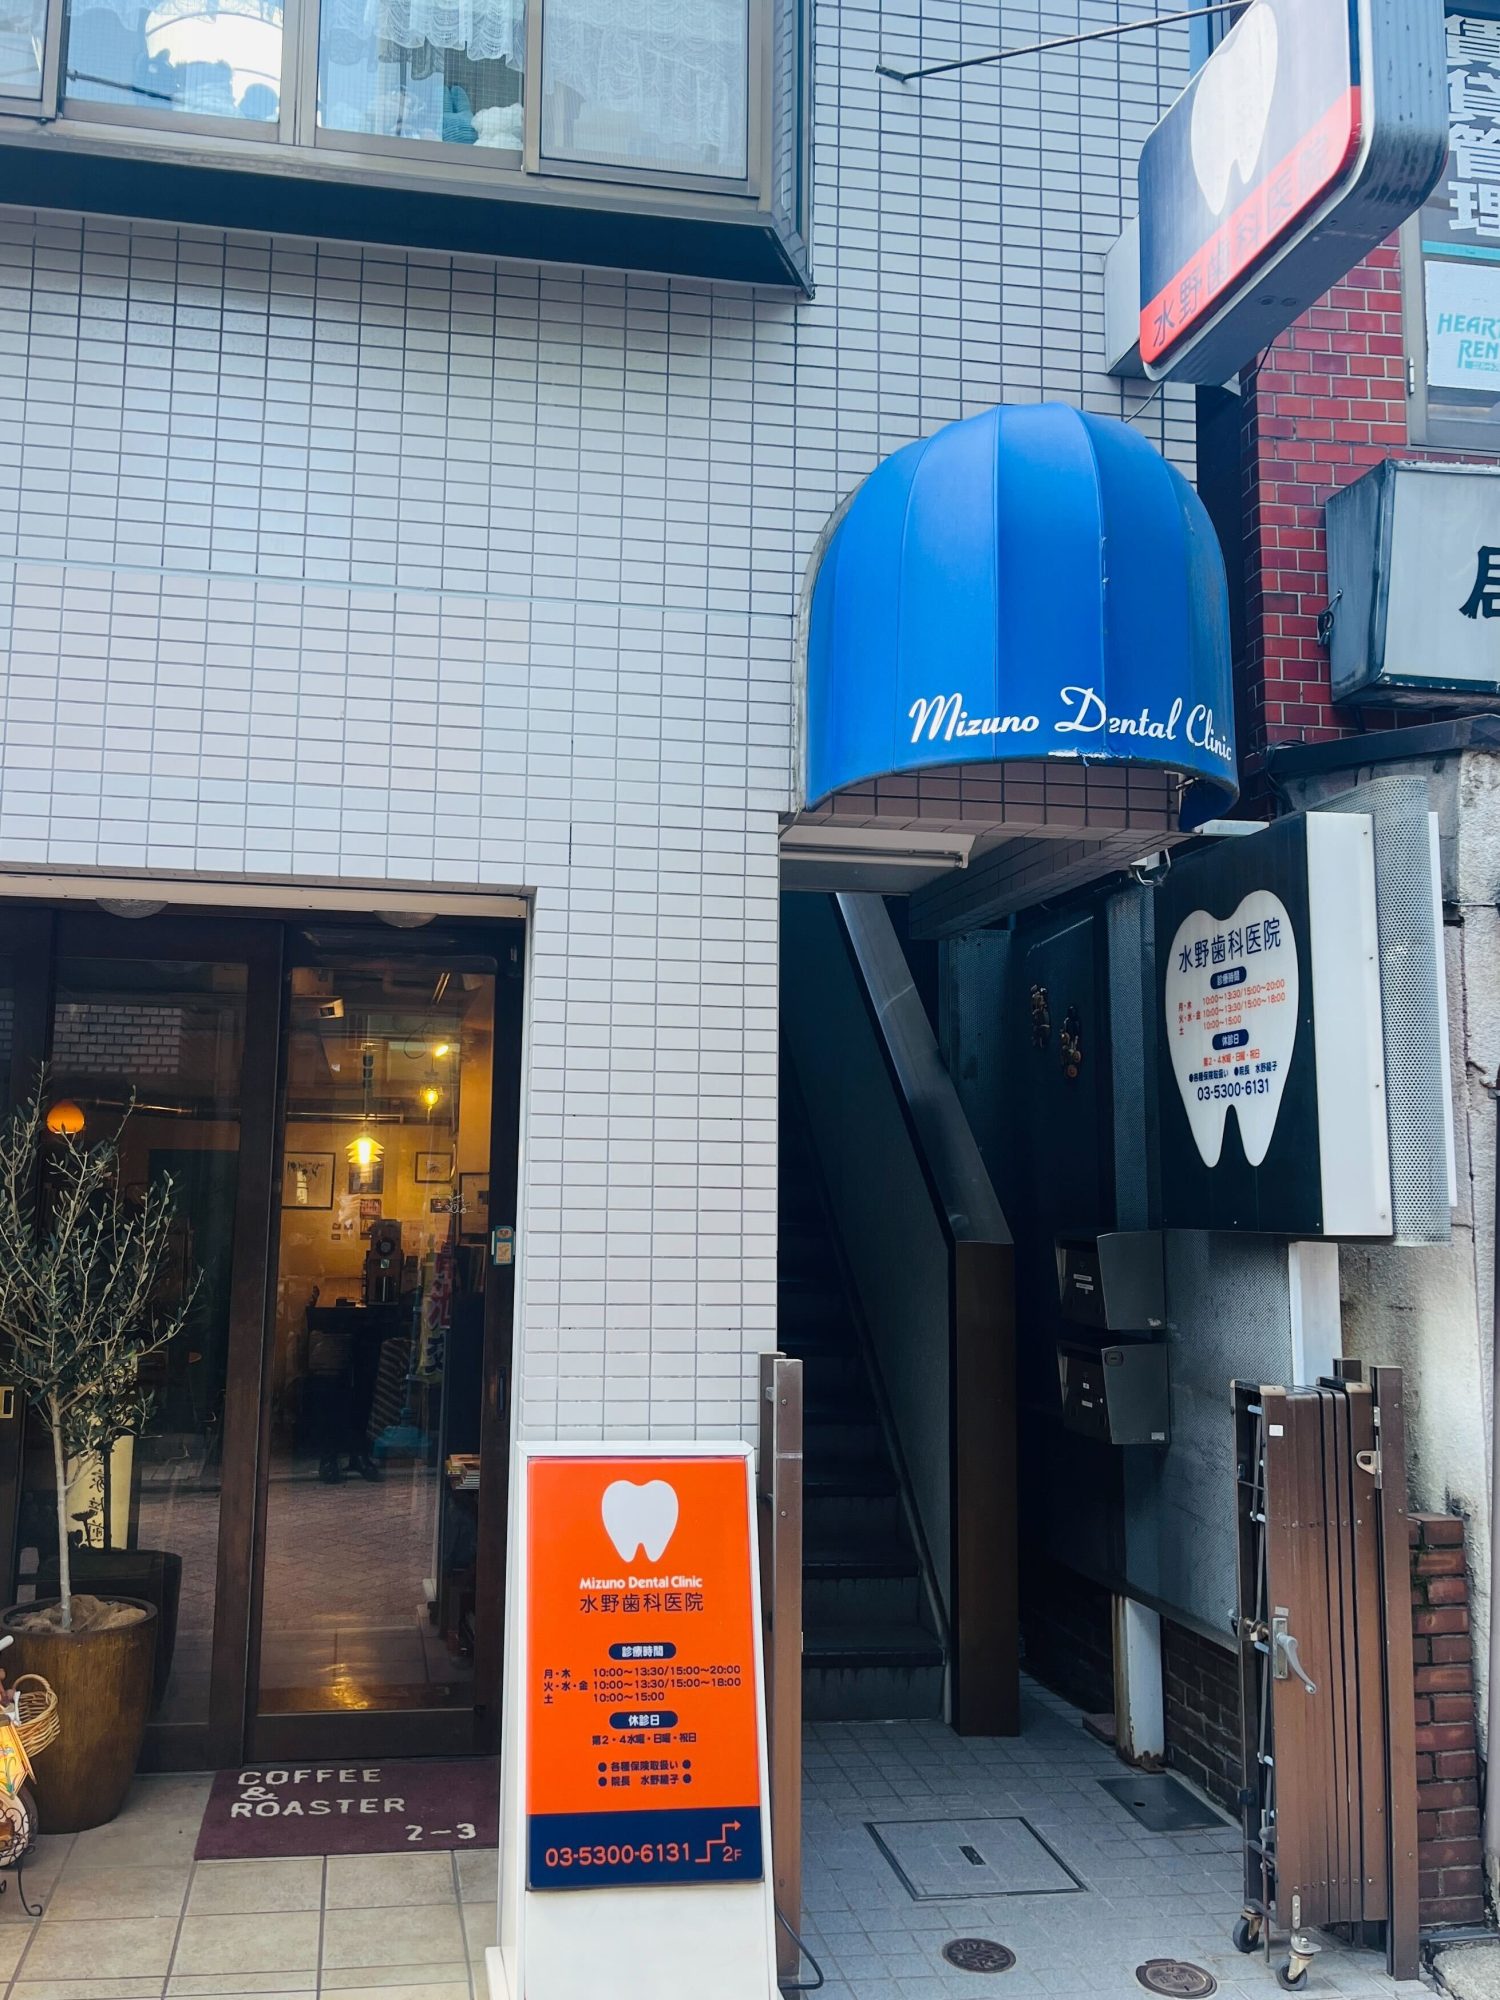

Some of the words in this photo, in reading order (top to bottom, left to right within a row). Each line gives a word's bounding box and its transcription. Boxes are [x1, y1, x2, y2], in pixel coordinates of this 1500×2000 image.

[1437, 313, 1500, 340] HEAR
[909, 692, 1040, 744] Mizuno
[1054, 686, 1183, 741] Dental
[1185, 703, 1232, 762] Clinic
[1178, 917, 1282, 974] 水野歯科医院
[1221, 1033, 1240, 1047] 休診日
[579, 1577, 626, 1590] Mizuno
[628, 1575, 669, 1588] Dental
[670, 1575, 703, 1588] Clinic
[579, 1592, 704, 1614] 水野歯科医院
[621, 1645, 664, 1658] 診療時間
[544, 1694, 553, 1705] 土
[628, 1714, 660, 1727] 休診日
[238, 1768, 381, 1786] COFFEE
[240, 1786, 279, 1800] &
[231, 1797, 405, 1818] ROASTER
[545, 1843, 690, 1867] 03-5300-6131
[722, 1847, 743, 1862] 2F
